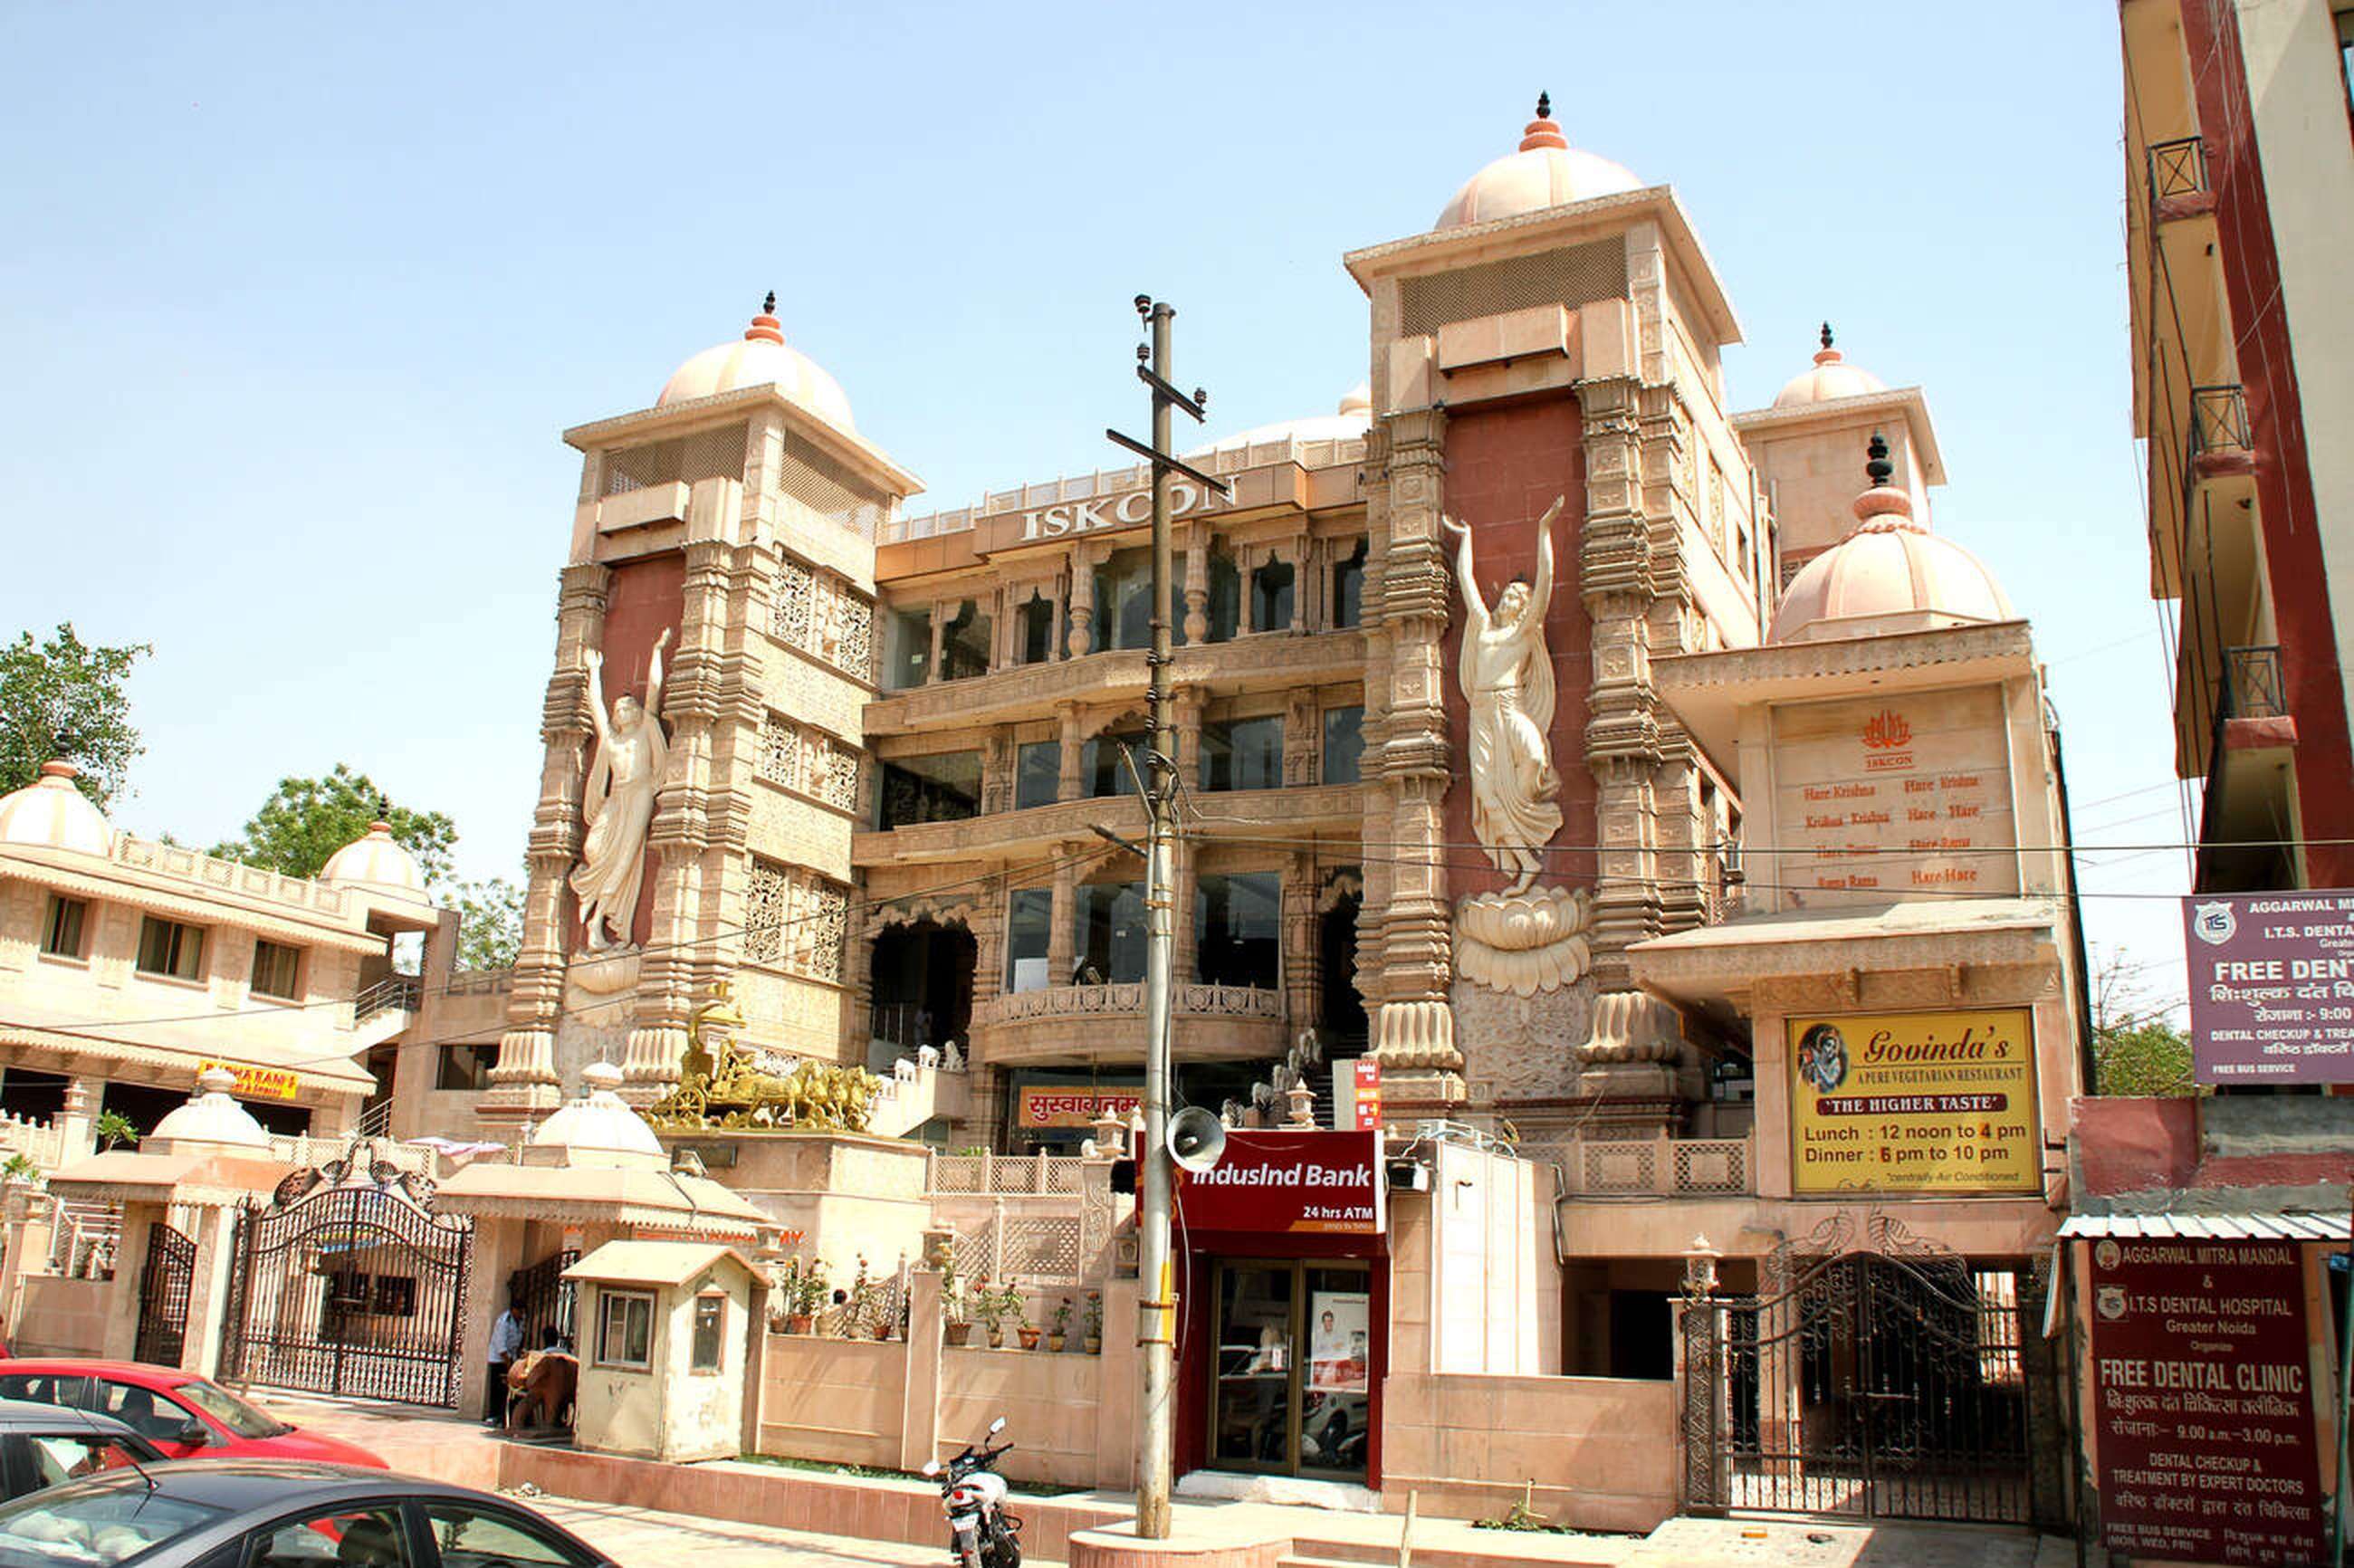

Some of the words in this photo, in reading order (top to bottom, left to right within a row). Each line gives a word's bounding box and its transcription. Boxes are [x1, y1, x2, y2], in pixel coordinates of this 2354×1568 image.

[2249, 899, 2334, 913] AGGARWAL
[2215, 961, 2283, 981] FREE
[2211, 1029, 2254, 1041] DENTAL
[2256, 1028, 2310, 1040] CHECKUP
[1864, 1026, 2009, 1064] Govinda's
[1865, 1070, 1889, 1085] PURE
[1890, 1069, 1956, 1085] VEGETARIAN
[1957, 1067, 2022, 1082] RESTAURANT
[1870, 1098, 1933, 1112] HIGHER
[1804, 1125, 1859, 1142] Lunch
[1880, 1124, 1899, 1140] 12
[1906, 1125, 1951, 1140] noon
[1957, 1123, 1976, 1139] to
[1980, 1122, 1991, 1138] 4
[1997, 1124, 2026, 1141] pm
[1805, 1147, 1863, 1163] Dinner
[1896, 1148, 1924, 1164] pm
[1928, 1146, 1947, 1160] to
[1956, 1145, 1974, 1160] 10
[1980, 1146, 2009, 1164] pm
[1192, 1162, 1302, 1188] IndusInd
[1306, 1162, 1372, 1188] Bank
[1303, 1205, 1318, 1219] 24
[1322, 1205, 1342, 1220] hrs
[1344, 1205, 1374, 1220] ATM
[2122, 1247, 2196, 1264] AGGARWAL
[2239, 1246, 2296, 1265] MANDAL
[2202, 1274, 2214, 1288] &
[2161, 1296, 2217, 1314] DENTAL
[2220, 1297, 2294, 1317] HOSPITAL
[2166, 1319, 2215, 1334] Greater
[2217, 1320, 2257, 1334] Noida
[2100, 1359, 2148, 1386] FREE
[2155, 1361, 2232, 1391] DENTAL
[2236, 1362, 2304, 1393] CLINIC
[2148, 1452, 2193, 1468] DENTAL
[2195, 1454, 2252, 1471] CHECKUP
[2111, 1468, 2178, 1487] TREATMENT
[2180, 1473, 2196, 1487] BY
[2198, 1474, 2244, 1491] EXPERT
[2246, 1477, 2304, 1495] DOCTORS
